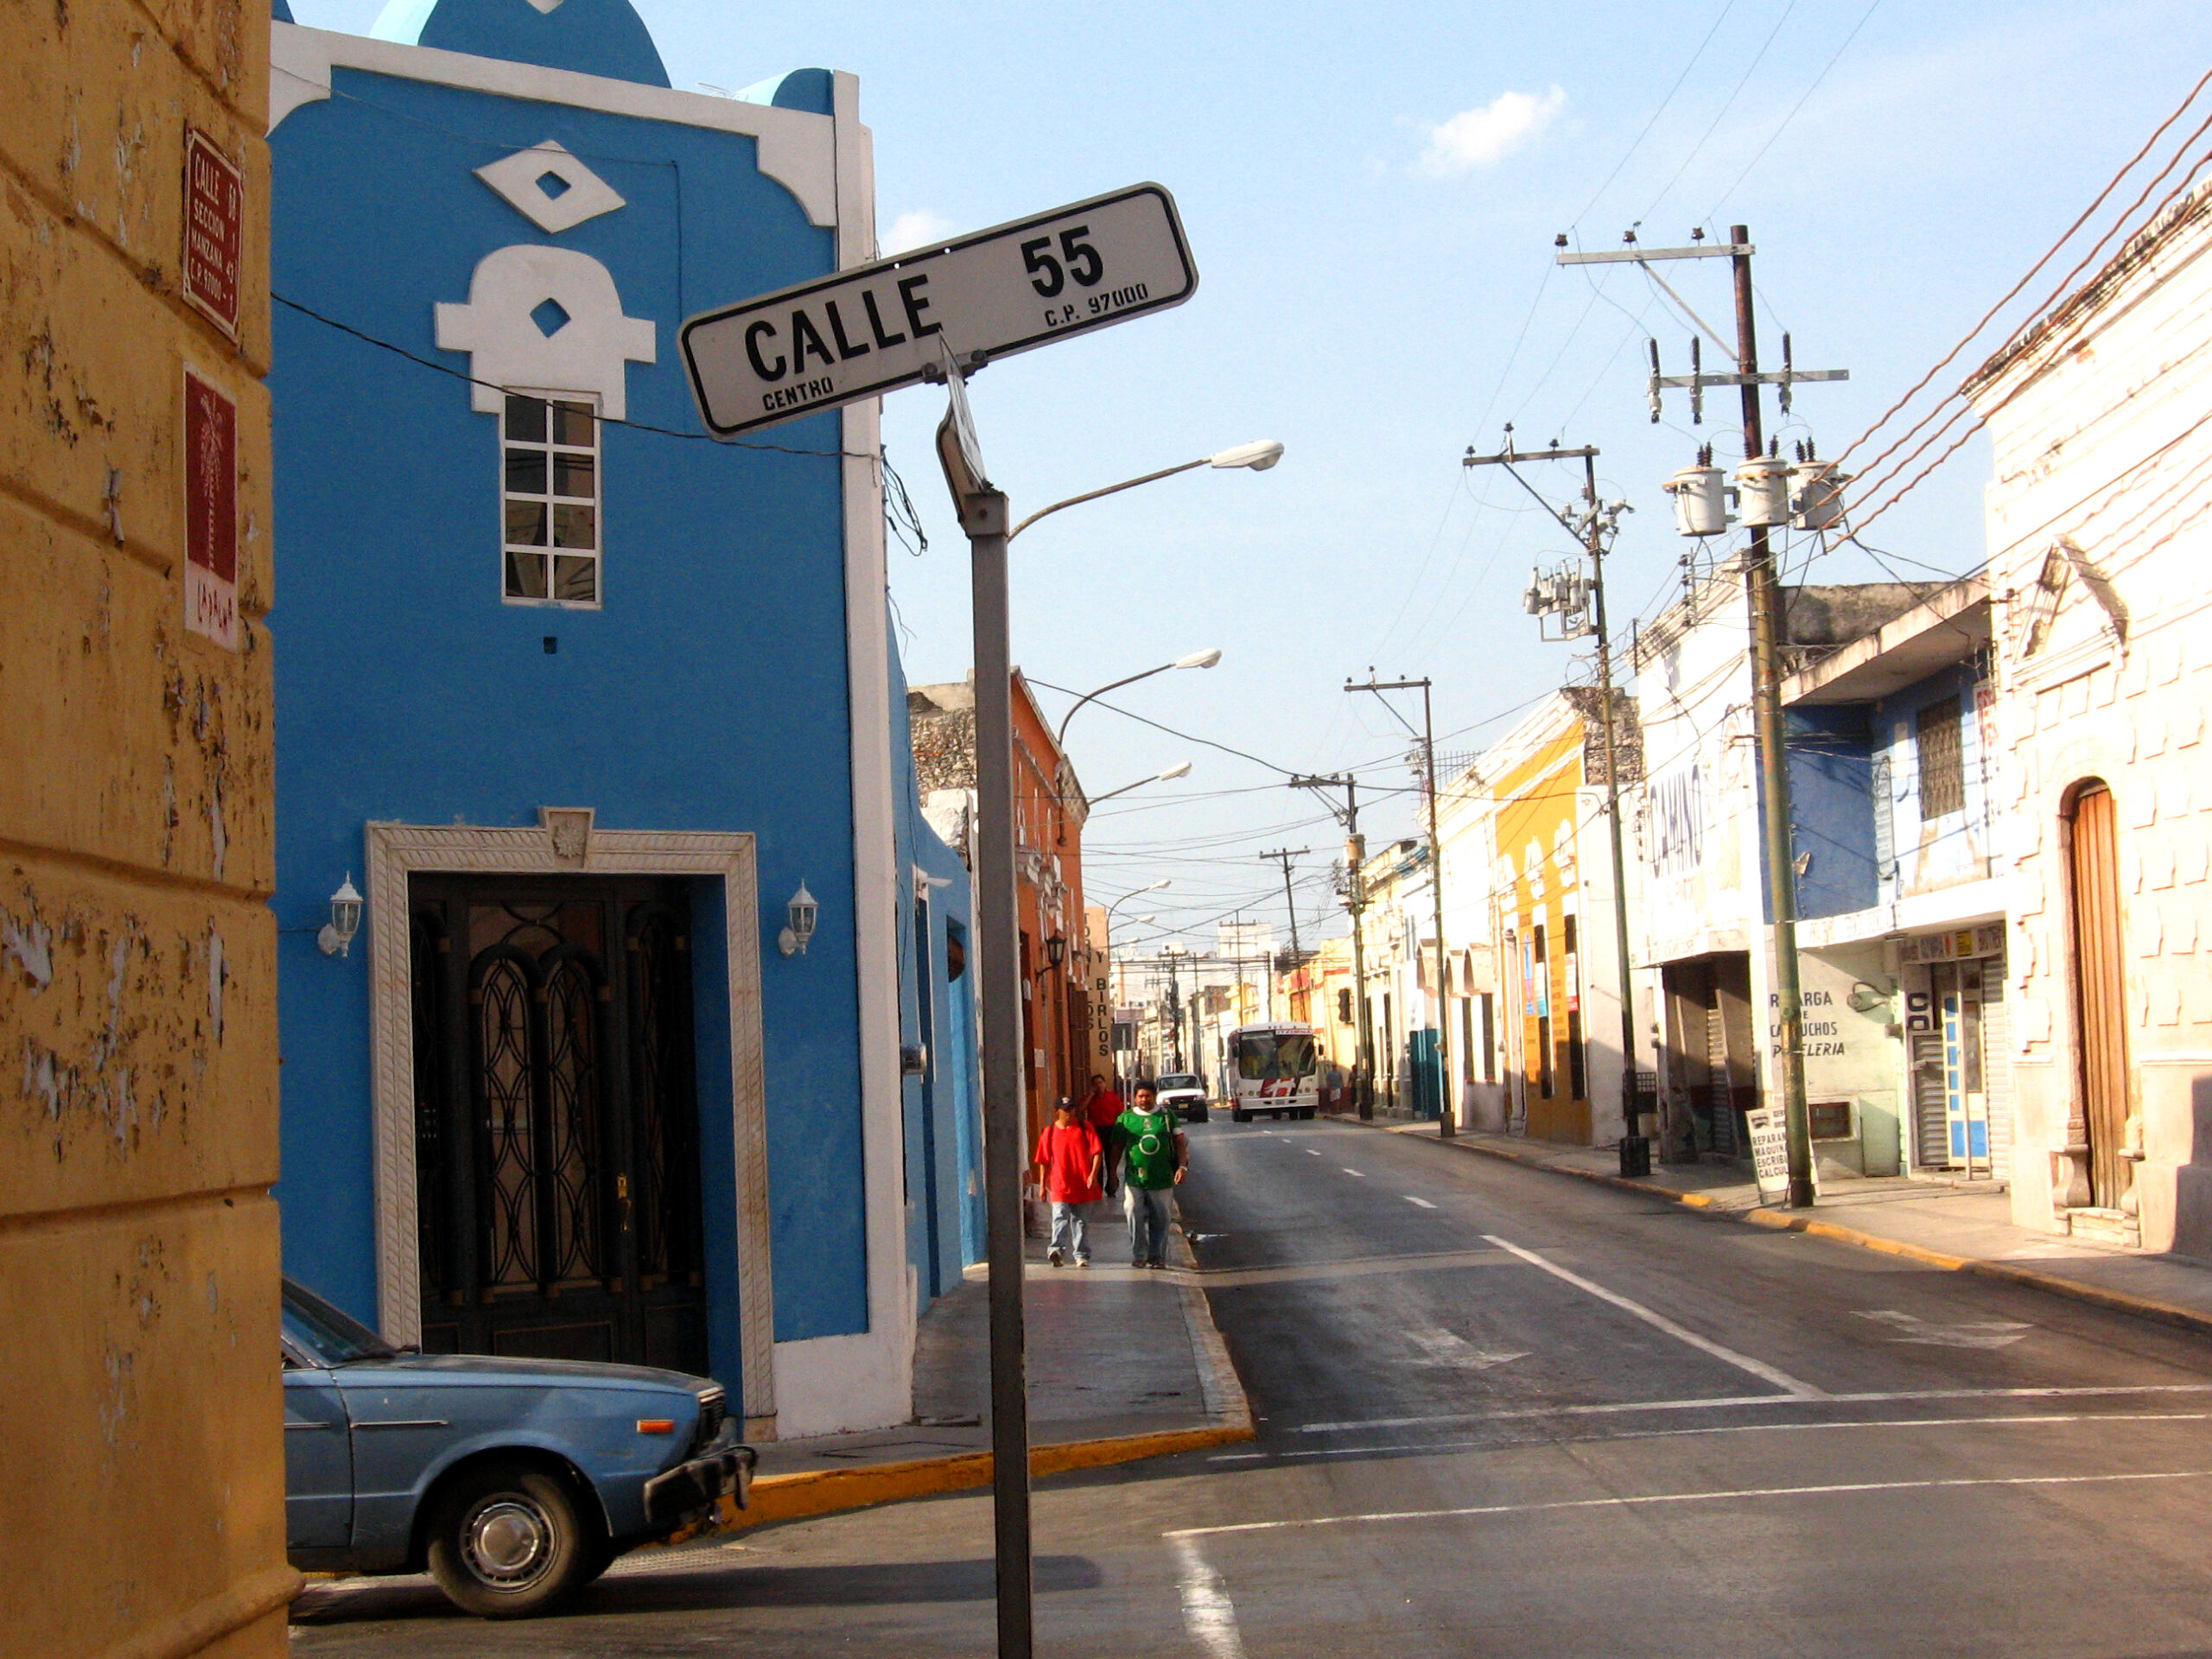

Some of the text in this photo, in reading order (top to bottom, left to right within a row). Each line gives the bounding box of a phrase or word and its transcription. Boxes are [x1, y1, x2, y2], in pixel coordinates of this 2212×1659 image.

[195, 152, 220, 206] CALLE
[194, 198, 225, 242] SECCION
[191, 226, 223, 272] MANZANA
[745, 226, 1104, 382] CALLE 55
[1045, 283, 1147, 327] C.P. 97000
[762, 376, 835, 411] CENTRO
[1096, 978, 1109, 1057] BIRLOS
